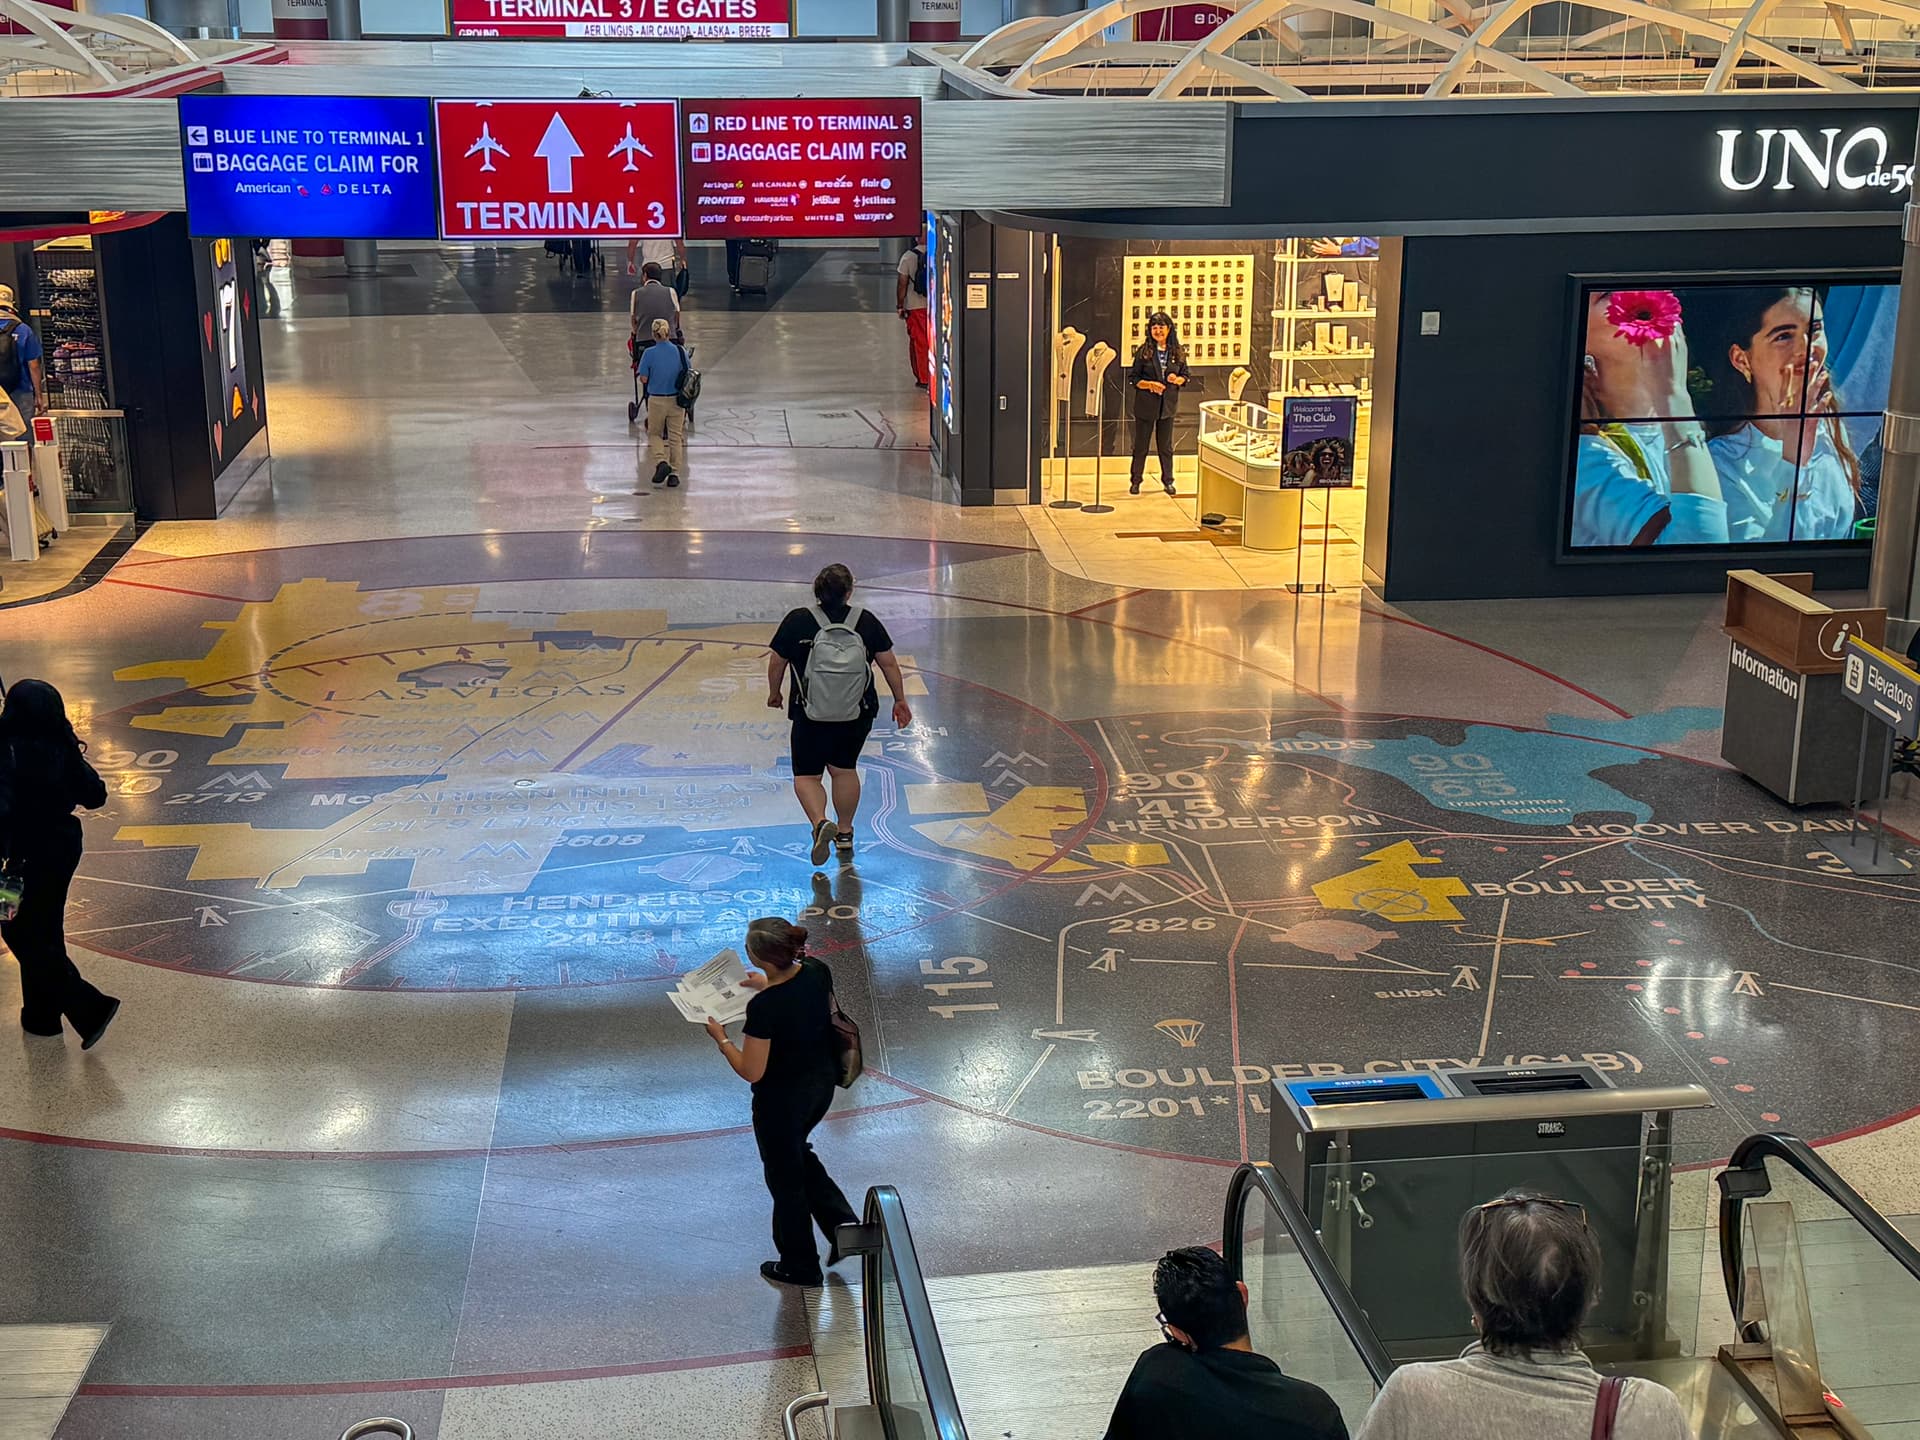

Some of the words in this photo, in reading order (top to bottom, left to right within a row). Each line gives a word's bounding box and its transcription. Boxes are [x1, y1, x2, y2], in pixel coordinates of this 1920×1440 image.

[484, 0, 613, 17] TERMINAL
[619, 0, 633, 18] 3
[654, 0, 670, 17] E
[677, 0, 757, 18] GATES
[921, 2, 955, 10] TERMINAL
[584, 25, 601, 36] AER
[604, 25, 634, 36] LINGUS
[641, 25, 655, 36] AIR
[657, 25, 691, 36] CANADA
[697, 25, 730, 36] ALASKA
[738, 26, 771, 37] BREEZE
[714, 116, 747, 132] RED
[751, 116, 789, 131] LINE
[792, 116, 814, 131] TO
[819, 115, 899, 131] TERMINAL
[902, 115, 913, 130] 3
[213, 130, 257, 144] BLUE
[261, 130, 299, 145] LINE
[303, 131, 324, 145] TO
[329, 131, 412, 146] TERMINAL
[416, 131, 425, 146] 1
[714, 143, 802, 162] BAGGAGE
[806, 142, 866, 161] CLAIM
[870, 142, 907, 160] FOR
[1715, 126, 1888, 191] UNO
[216, 154, 309, 173] BAGGAGE
[314, 154, 375, 173] CLAIM
[381, 156, 420, 174] FOR
[235, 182, 292, 195] American
[338, 183, 393, 196] DELTA
[698, 196, 745, 205] FRONTIER
[456, 202, 637, 230] TERMINAL
[648, 201, 666, 230] 3
[700, 213, 728, 224] porter
[1293, 413, 1311, 423] The
[1313, 413, 1336, 422] Club
[1731, 641, 1799, 700] Information
[323, 688, 430, 701] LAS
[450, 684, 626, 699] VEGAS
[1867, 664, 1914, 712] Elevators
[1255, 739, 1376, 752] KIDDS
[1407, 753, 1494, 772] 90
[1126, 771, 1209, 791] 90
[1430, 780, 1518, 798] 65
[163, 791, 267, 805] 2713
[1448, 797, 1567, 808] transformer
[1137, 798, 1225, 818] 45
[1503, 805, 1572, 815] station
[1106, 813, 1383, 833] HENDERSON
[1567, 821, 1760, 837] HOOVER
[1764, 818, 1870, 834] DAM
[1471, 877, 1705, 897] BOULDER
[503, 887, 802, 911] HENDERSON
[1605, 894, 1708, 910] CITY
[433, 909, 704, 933] EXECUTIVE
[1107, 916, 1218, 934] 2826
[919, 955, 1000, 1019] 115
[1374, 987, 1448, 1000] subst
[1077, 1062, 1346, 1090] BOULDER
[1364, 1057, 1482, 1075] CITY
